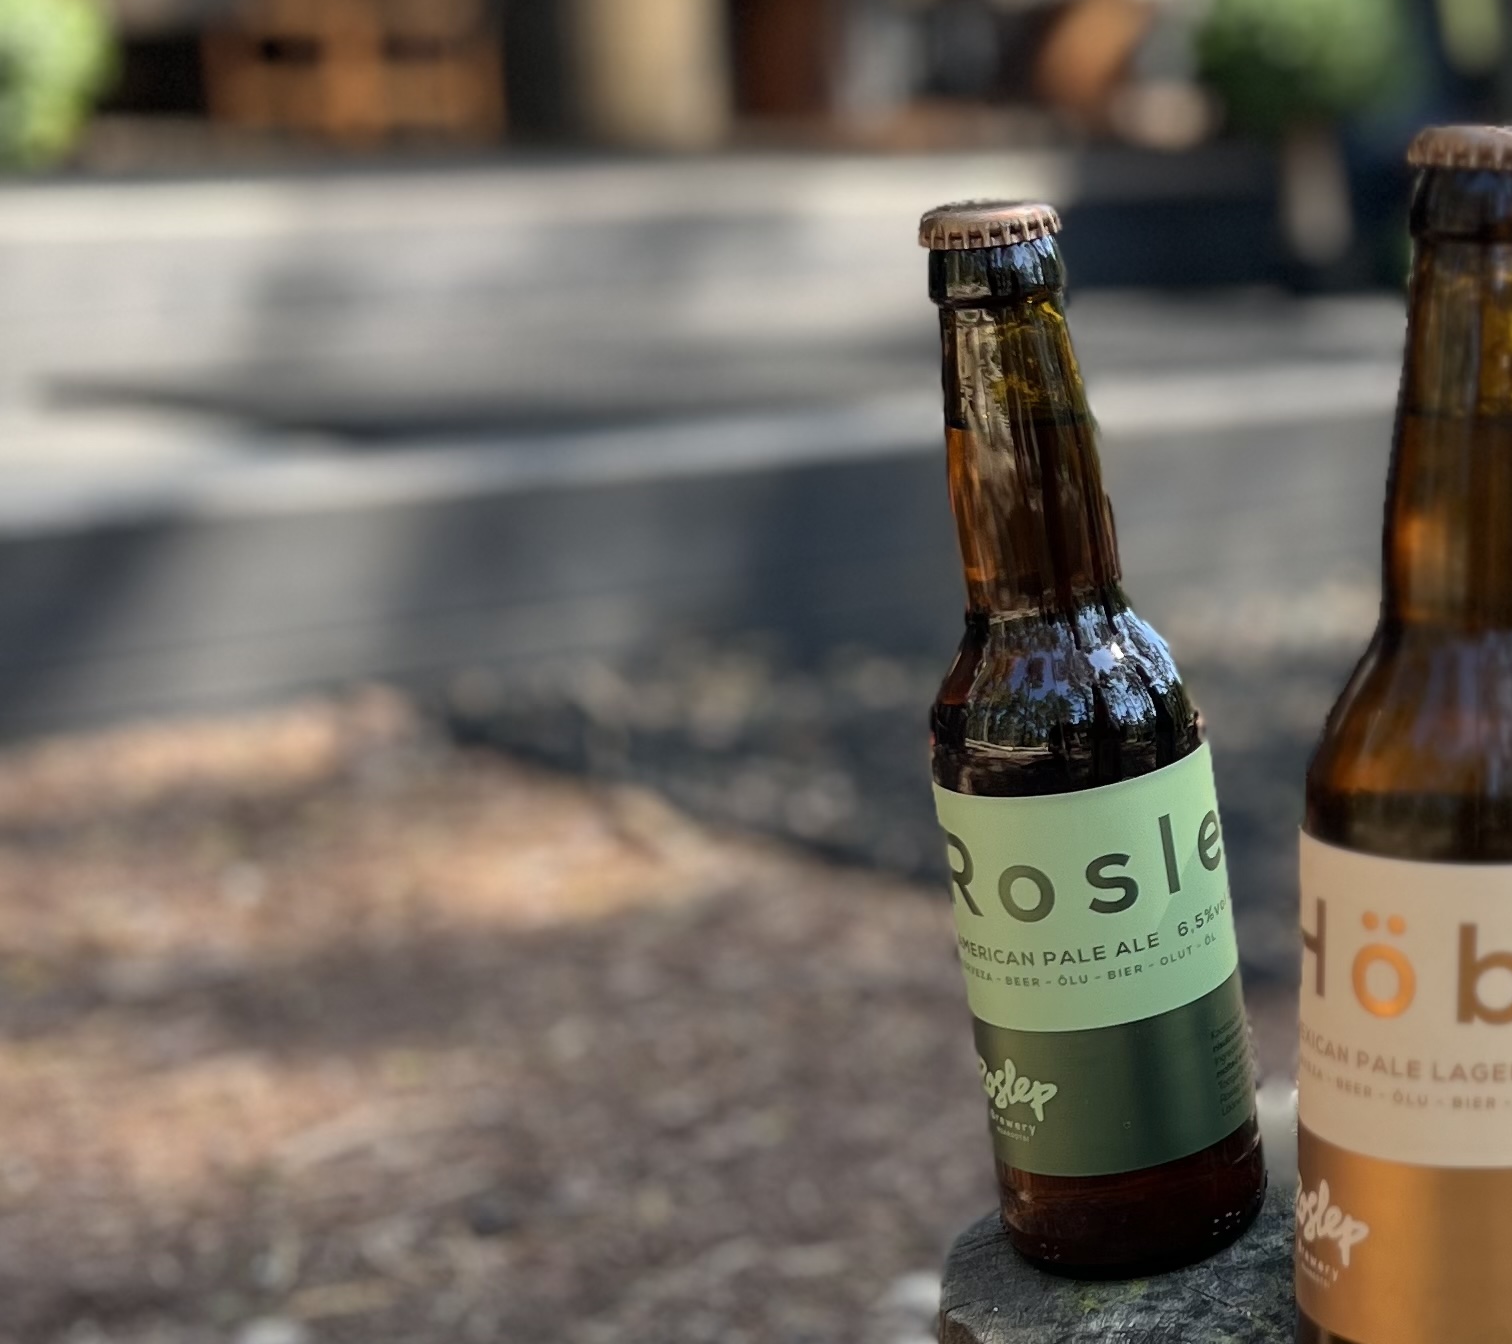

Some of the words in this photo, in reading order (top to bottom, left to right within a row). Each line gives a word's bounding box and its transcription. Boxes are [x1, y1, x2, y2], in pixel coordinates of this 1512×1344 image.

[948, 809, 1222, 922] Rosle
[1005, 975, 1040, 987] BEER
[1107, 964, 1143, 980] BIER
[1160, 945, 1192, 966] OLUT
[1043, 943, 1107, 966] PALE
[1116, 932, 1160, 957] ALE
[1357, 1050, 1421, 1080] PALE
[1297, 1171, 1369, 1267] oslep
